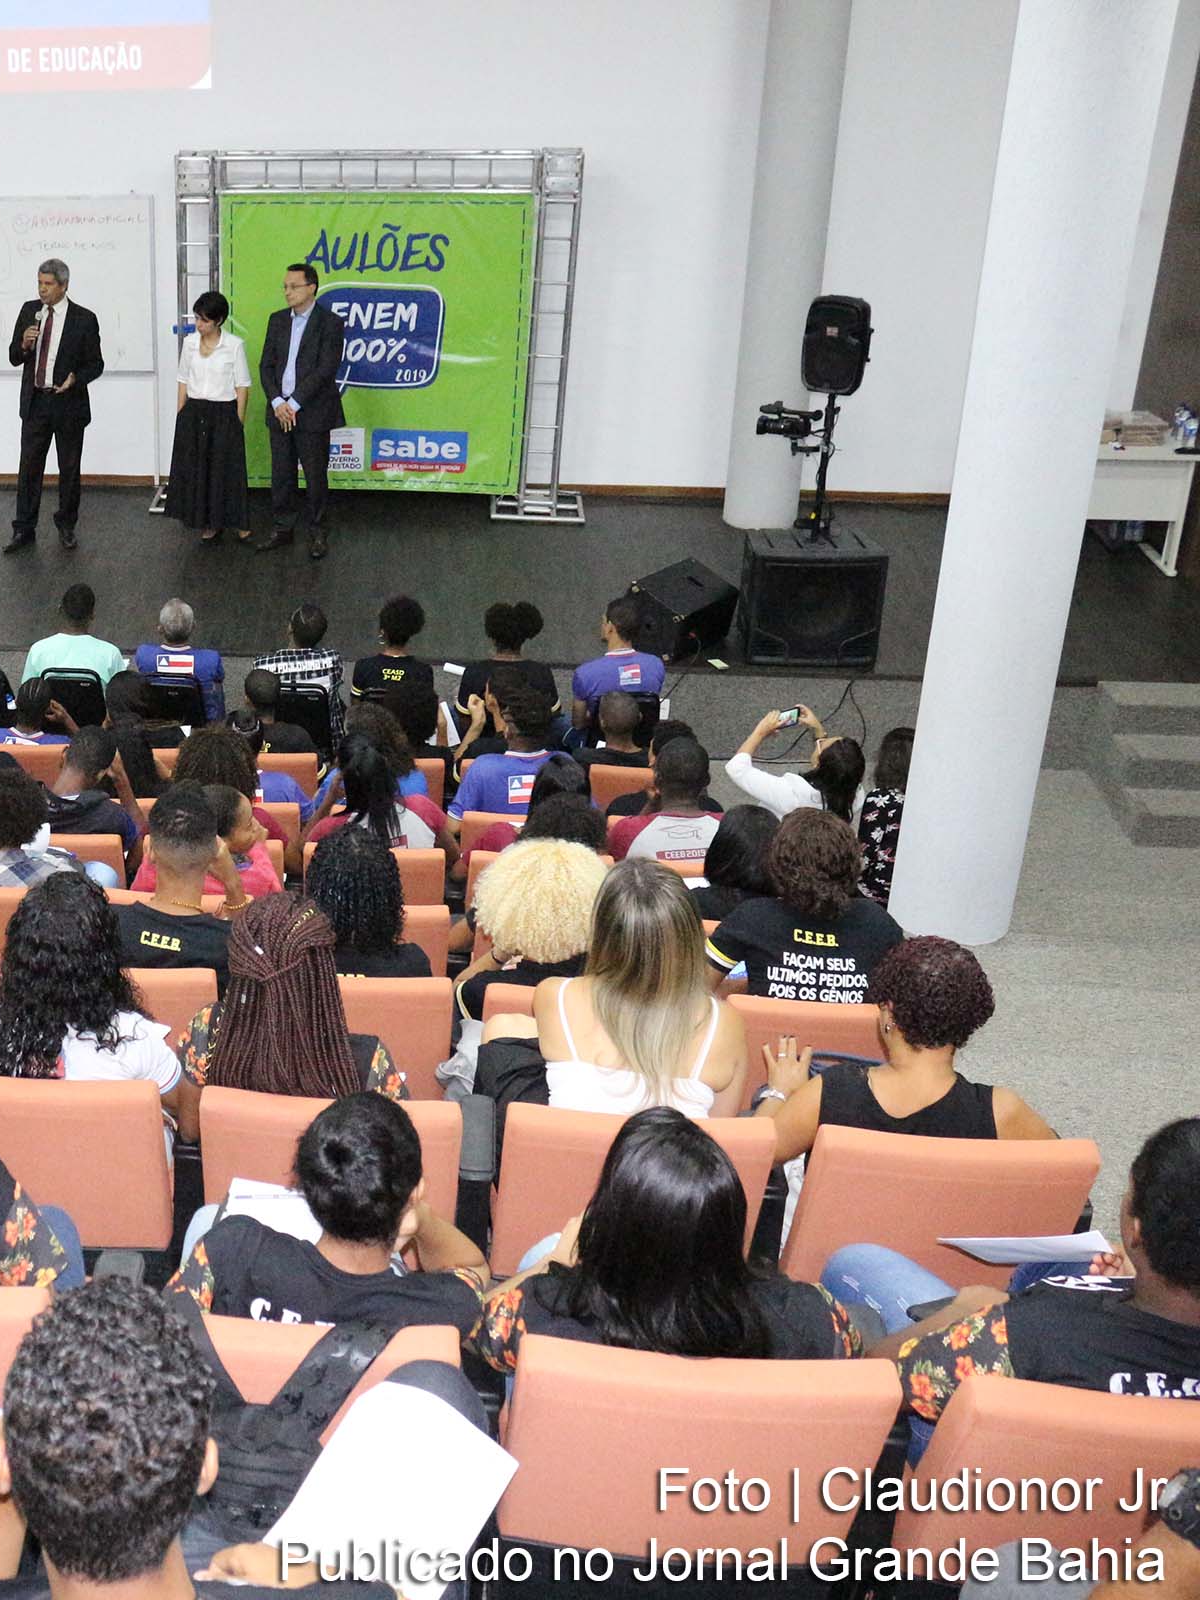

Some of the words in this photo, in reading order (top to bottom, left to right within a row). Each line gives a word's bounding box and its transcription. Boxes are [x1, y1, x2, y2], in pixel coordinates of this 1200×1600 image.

[8, 47, 33, 73] DE
[38, 41, 143, 76] EDUCAÇÃO
[305, 223, 450, 274] AULÕES
[331, 302, 418, 332] ENEM
[395, 369, 427, 382] 2019
[378, 436, 461, 459] sabe
[793, 928, 839, 948] C.E.E.B.
[783, 951, 824, 971] FAÇAM
[826, 957, 856, 972] SEUS
[767, 965, 817, 985] ULTIMOS
[768, 982, 797, 999] POIS
[799, 986, 817, 1001] OS
[820, 985, 864, 1004] GÊNIOS
